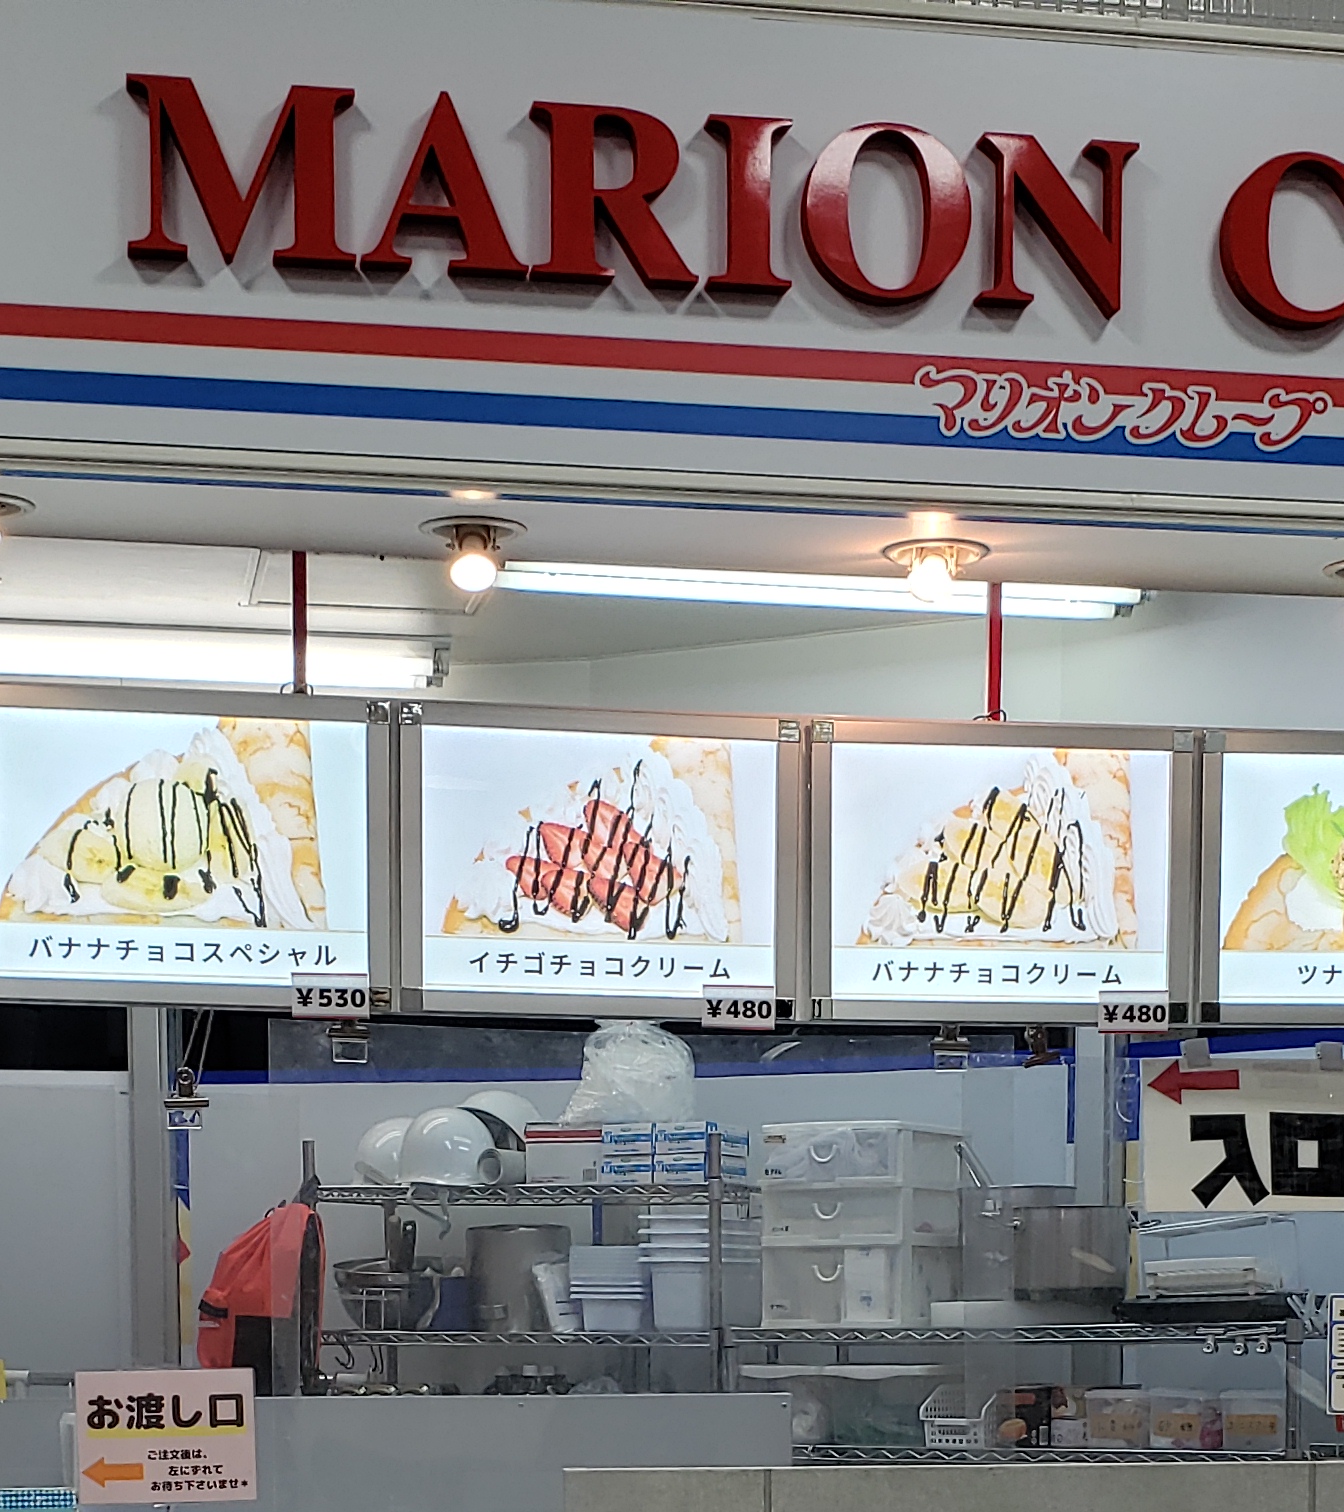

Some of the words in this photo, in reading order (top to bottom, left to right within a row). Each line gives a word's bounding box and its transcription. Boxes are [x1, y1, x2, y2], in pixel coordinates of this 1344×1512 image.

[125, 72, 1139, 323] MARION
[916, 366, 1332, 451] マリオンクレープ
[27, 934, 339, 968] バナナチョコスペシャル
[468, 949, 732, 982] イチゴチョコクリーム
[872, 957, 1125, 988] バナナチョコクリーム
[296, 985, 368, 1010] ¥530
[705, 998, 773, 1022] ¥480
[1102, 1002, 1168, 1026] ¥480
[87, 1393, 245, 1430] お渡し口
[168, 1465, 224, 1476] 左にずれて
